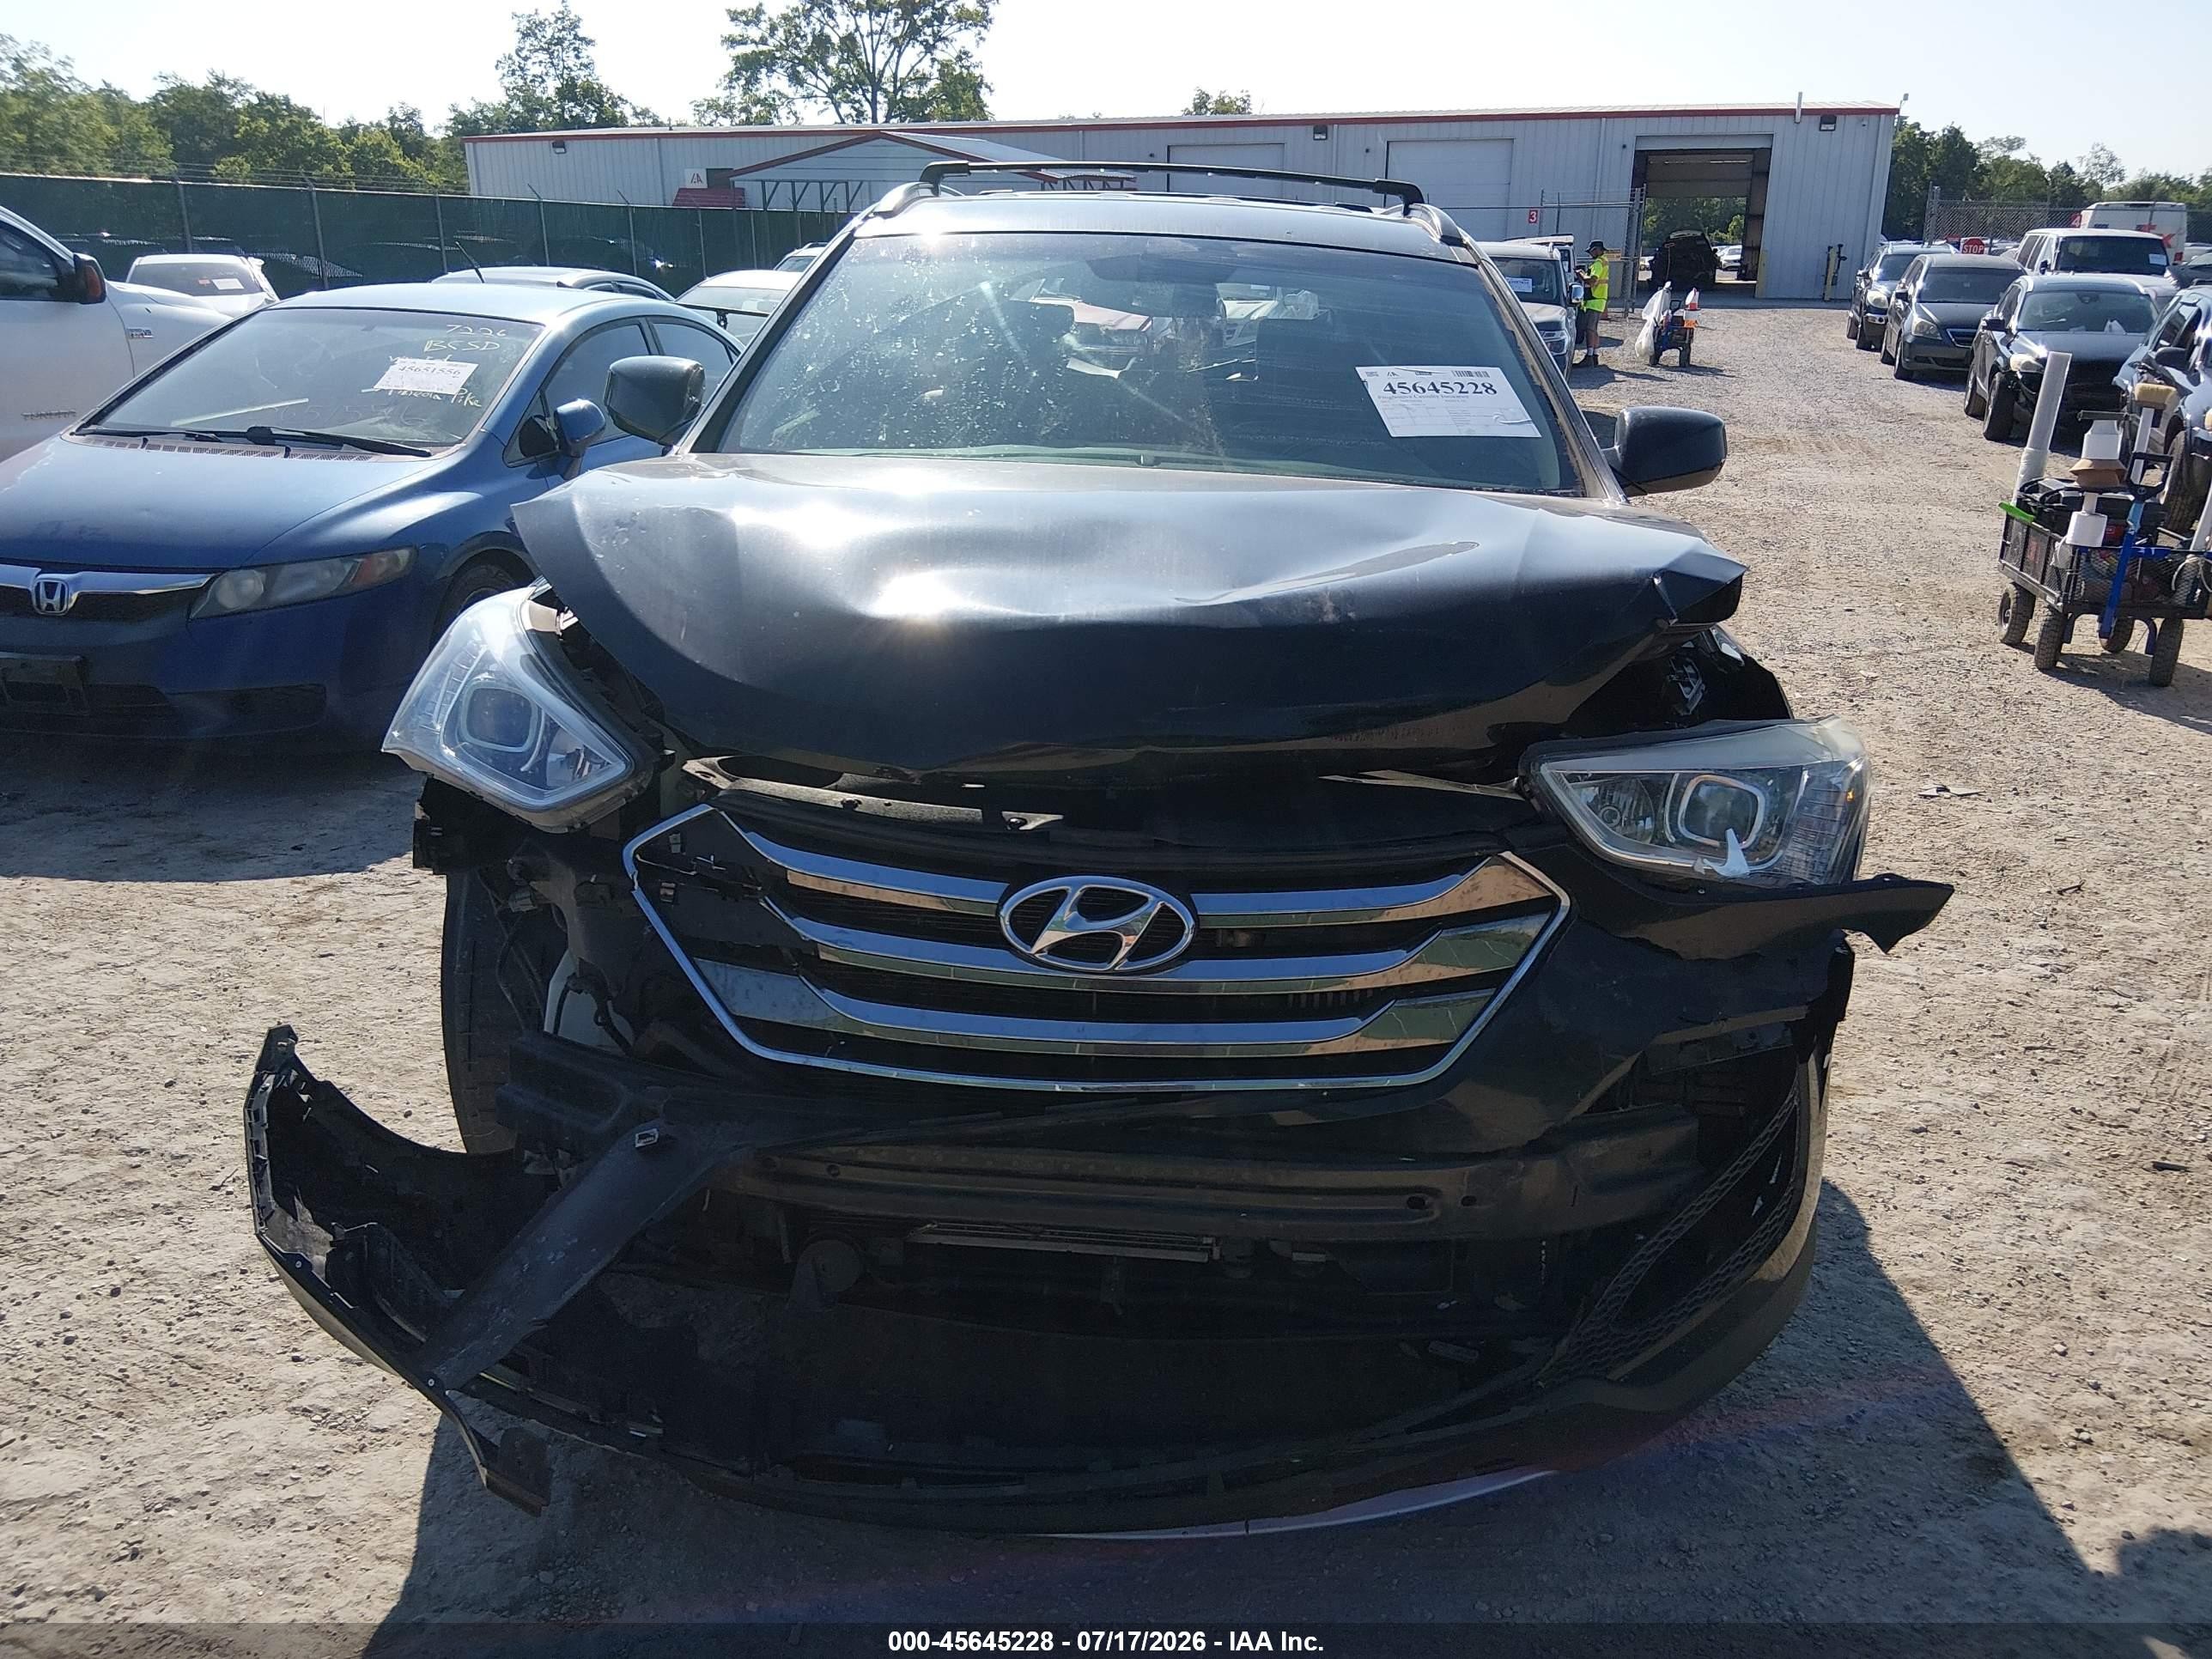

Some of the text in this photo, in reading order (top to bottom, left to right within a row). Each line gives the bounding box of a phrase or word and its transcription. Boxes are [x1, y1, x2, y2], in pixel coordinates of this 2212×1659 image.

[1529, 210, 1537, 222] 3
[1963, 245, 1984, 253] STOP
[447, 324, 507, 337] 7226
[1382, 381, 1497, 395] 45645228
[451, 387, 483, 407] Pike
